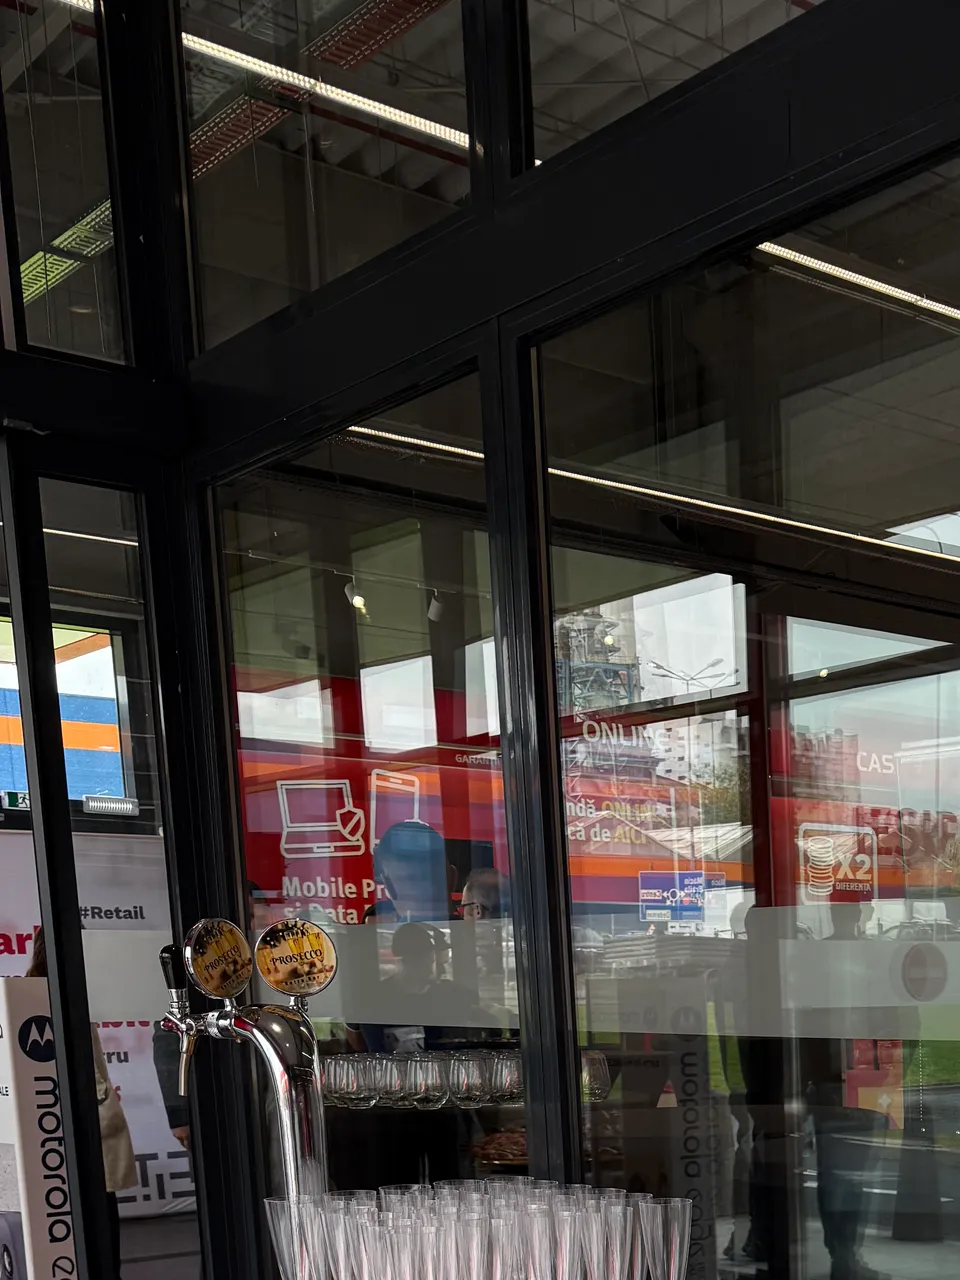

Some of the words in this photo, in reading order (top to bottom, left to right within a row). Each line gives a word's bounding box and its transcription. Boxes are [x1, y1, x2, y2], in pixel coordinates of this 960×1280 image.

[582, 720, 669, 751] ONLINE
[856, 751, 899, 775] CAS
[590, 823, 611, 842] de
[836, 853, 872, 880] X2
[282, 876, 358, 899] Mobile
[203, 944, 240, 973] PROSECCO
[271, 948, 323, 967] PROSECCO
[34, 1076, 73, 1243] motorola
